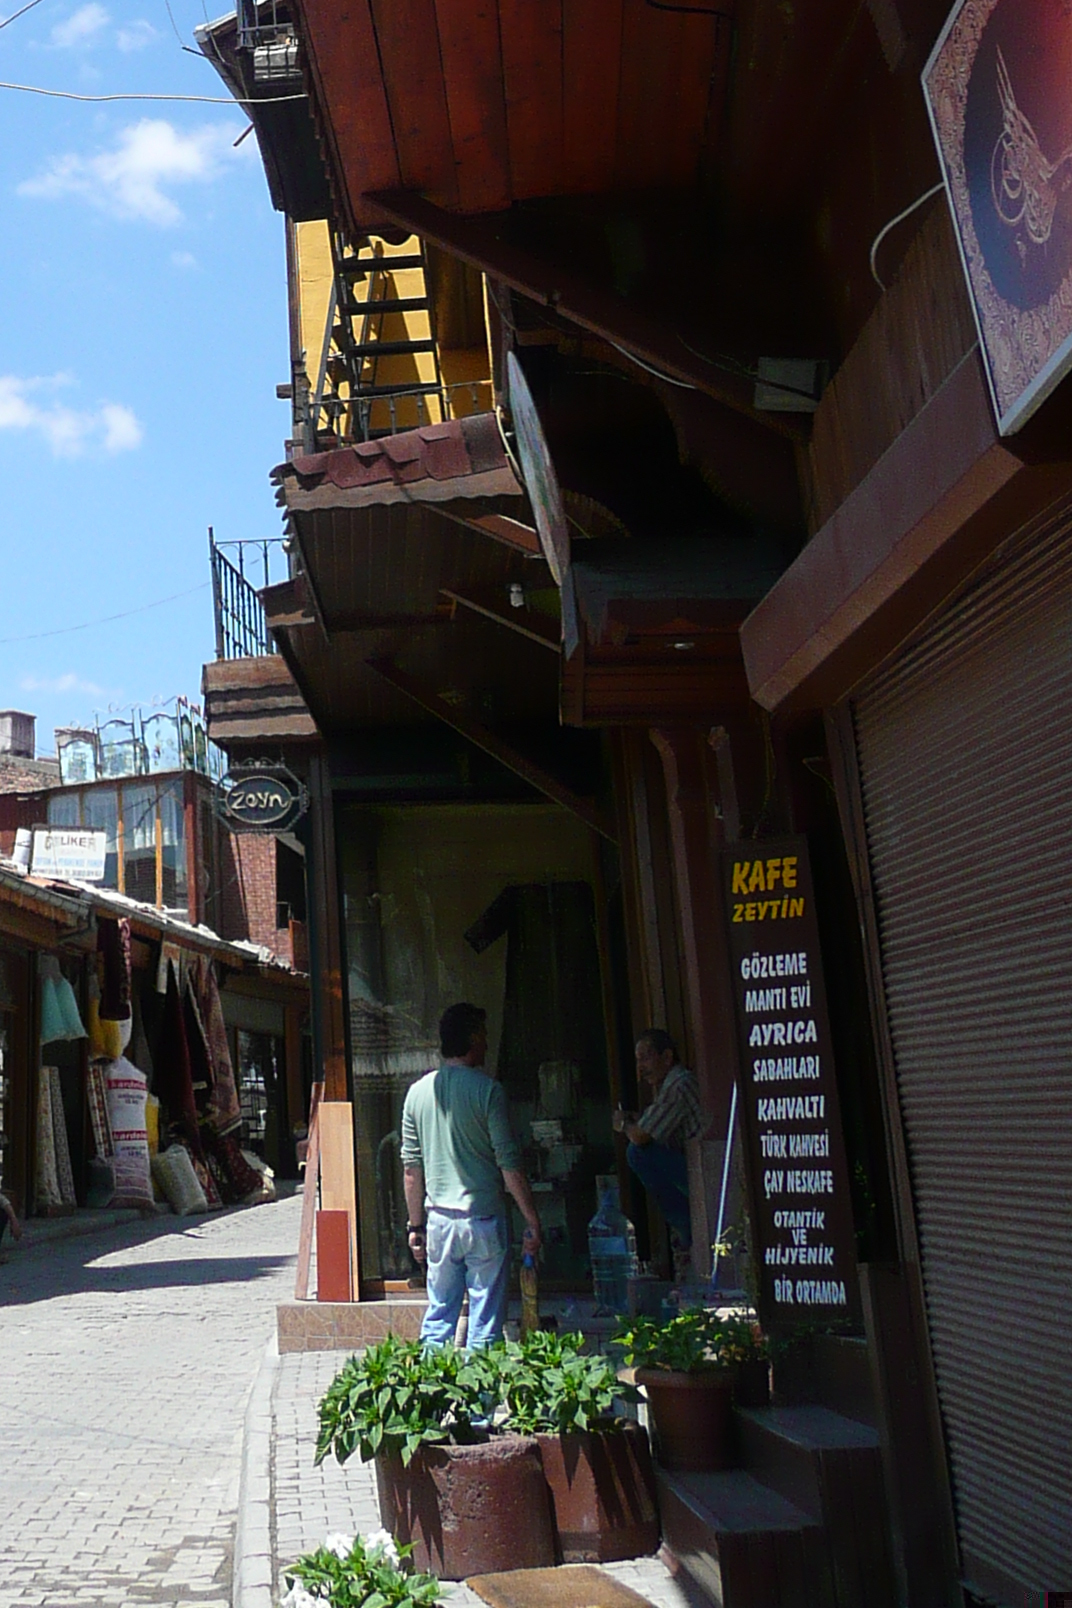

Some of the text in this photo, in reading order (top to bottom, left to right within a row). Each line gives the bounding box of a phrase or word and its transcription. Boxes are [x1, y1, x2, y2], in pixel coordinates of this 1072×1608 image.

[732, 856, 798, 895] KAFE
[732, 894, 805, 923] ZEYTİN
[741, 952, 807, 980] GÖZLEME
[745, 980, 811, 1013] MANTI EVİ
[749, 1020, 817, 1047] AYRICA
[753, 1055, 820, 1082] SABAHLARI
[758, 1095, 825, 1122] KAHVALTI
[760, 1128, 830, 1158] TÜRK KAHVESİ
[764, 1170, 833, 1199] ÇAY NESKAFE
[774, 1207, 825, 1229] OTANTİK
[792, 1229, 808, 1246] VE
[764, 1243, 834, 1266] HİJYENİK
[774, 1273, 847, 1305] BİR ORTAMDA
